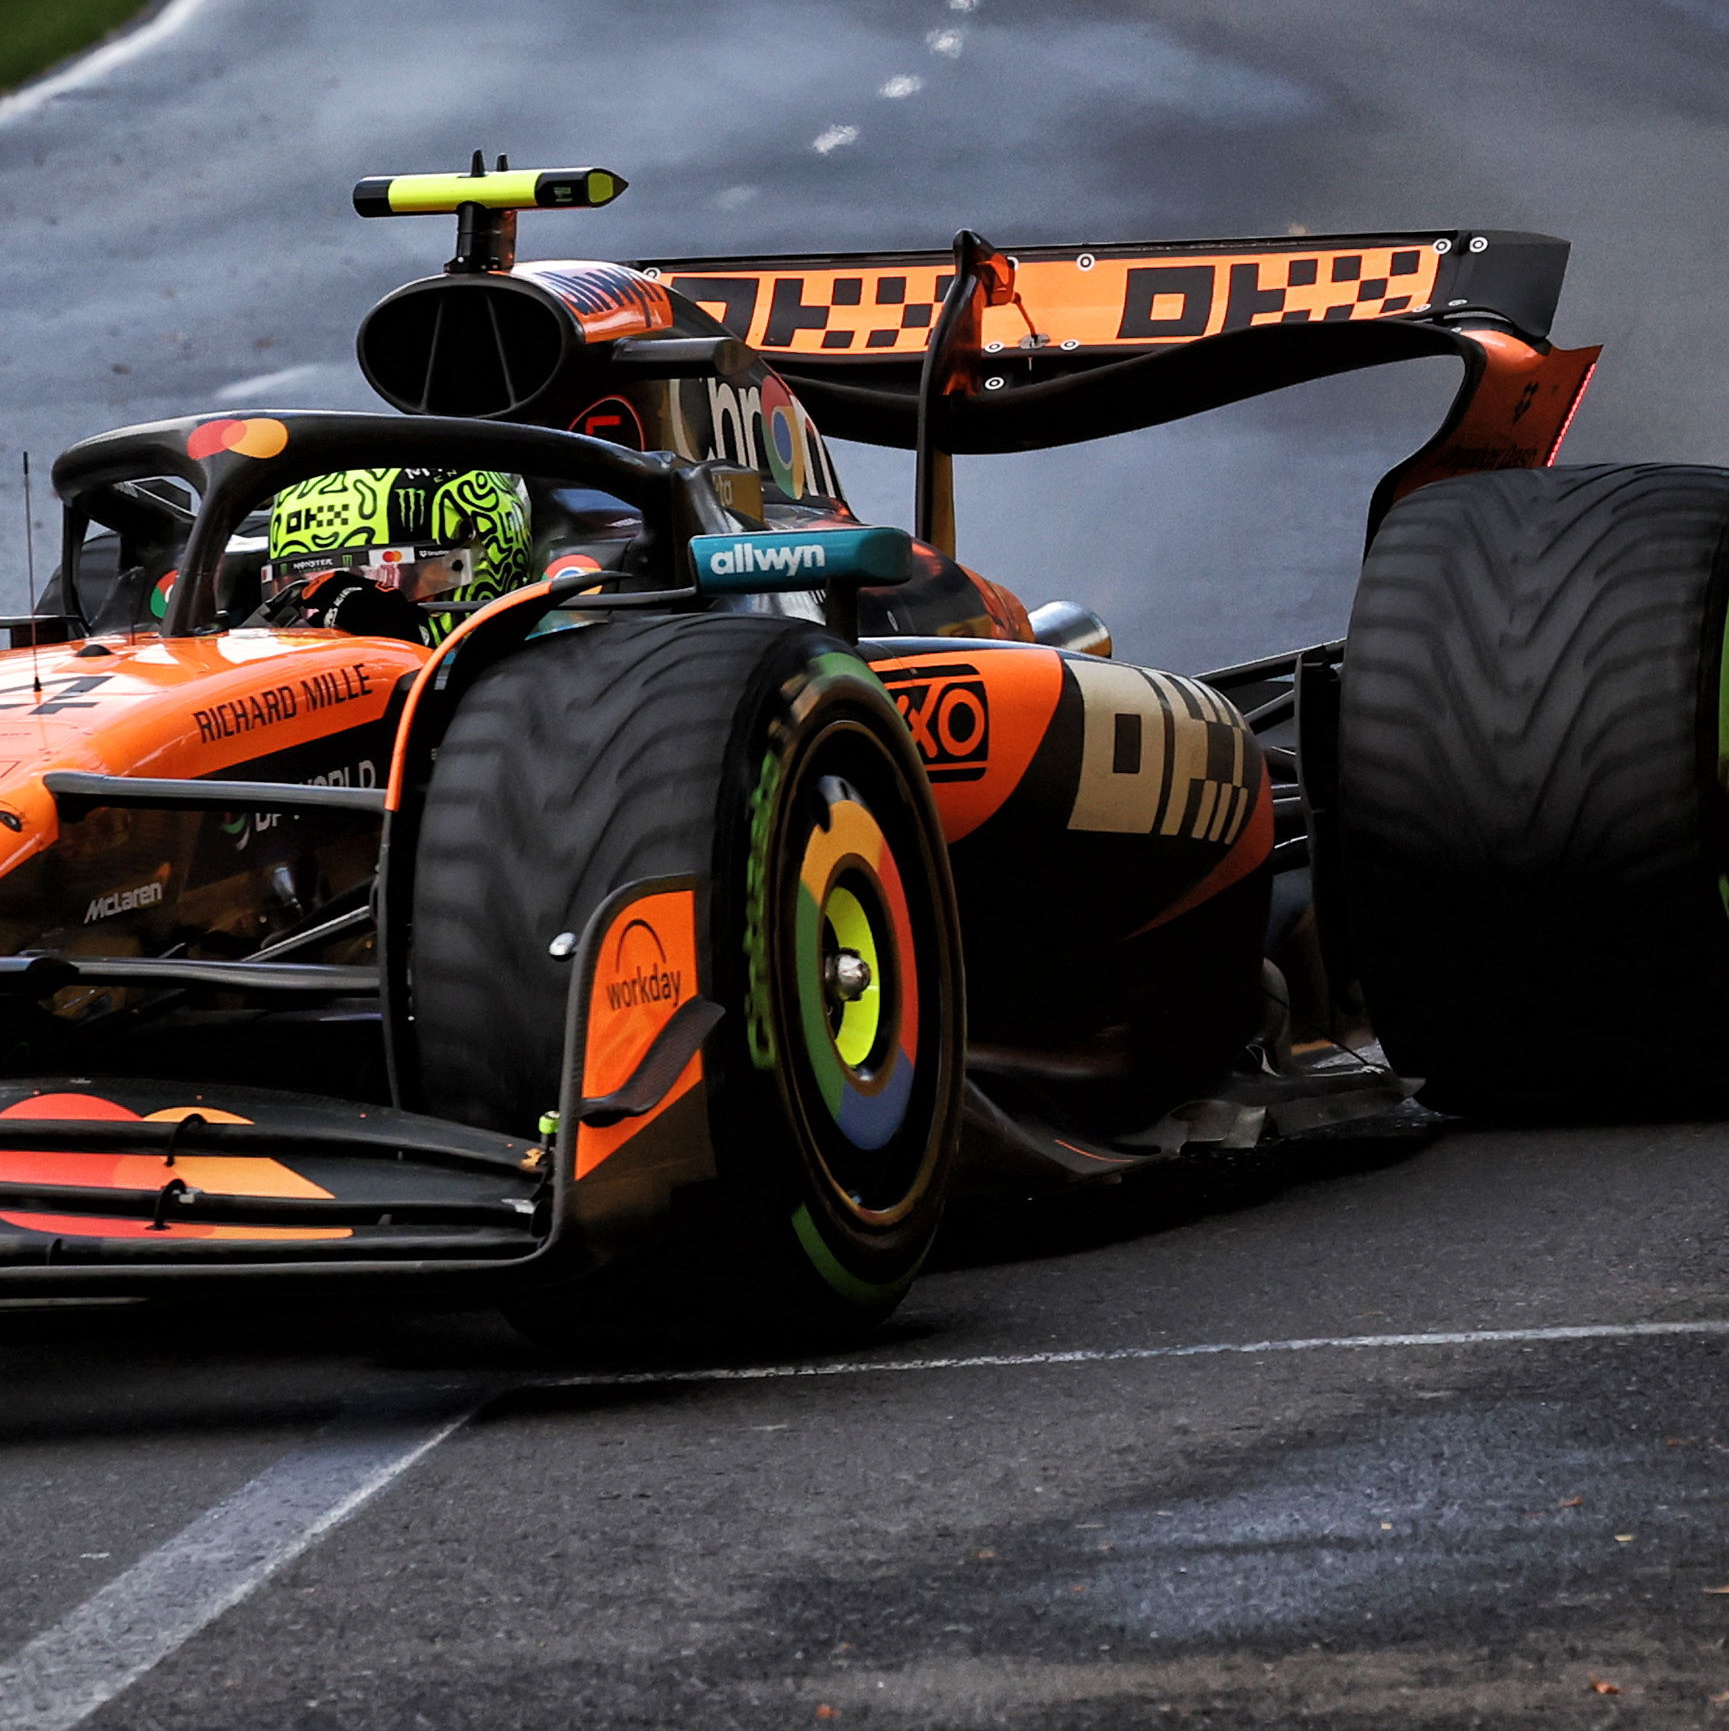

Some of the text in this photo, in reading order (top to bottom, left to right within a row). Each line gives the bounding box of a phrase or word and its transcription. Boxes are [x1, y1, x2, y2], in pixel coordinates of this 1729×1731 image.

[711, 543, 825, 577] allwyn
[193, 663, 371, 742] RICHARD MILLE
[83, 880, 163, 924] McLaren
[606, 966, 682, 1011] workday
